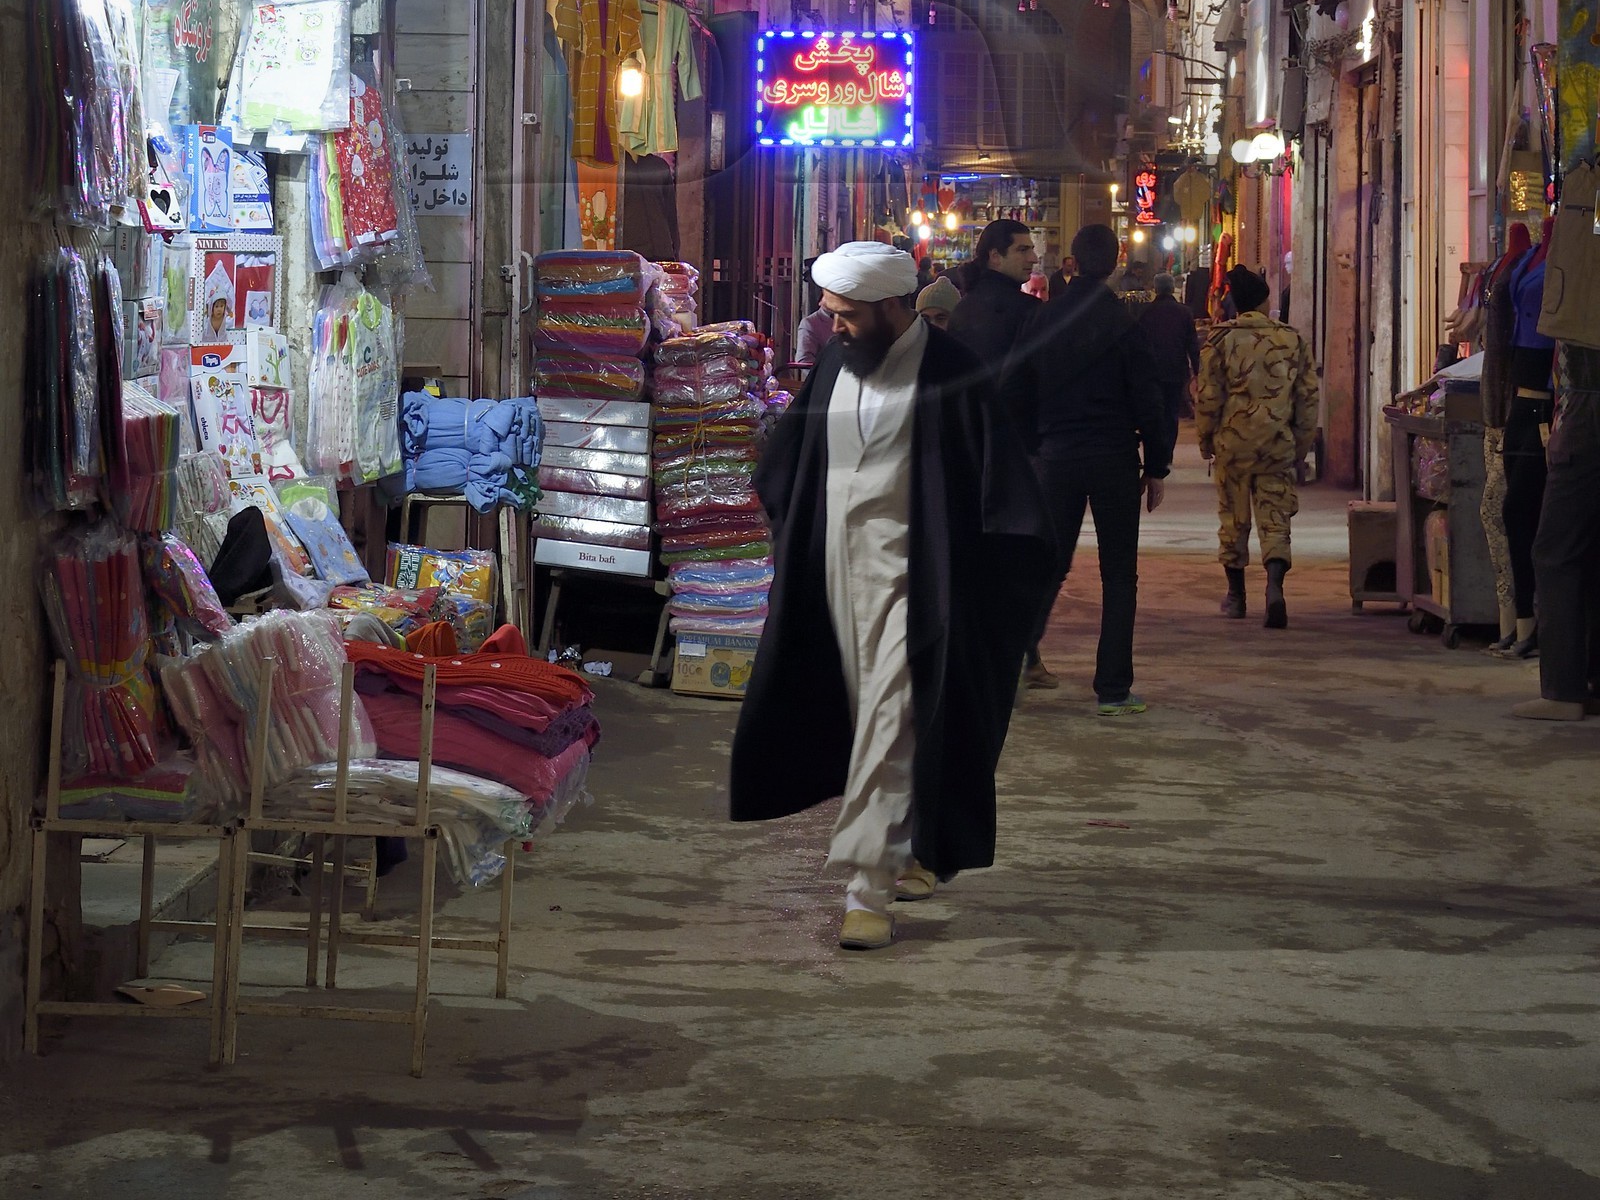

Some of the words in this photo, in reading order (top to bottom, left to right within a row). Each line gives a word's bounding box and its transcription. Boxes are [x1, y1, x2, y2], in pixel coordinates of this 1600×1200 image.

[794, 36, 875, 76] پخش
[857, 71, 906, 105] شال
[407, 136, 449, 161] تولید
[424, 188, 468, 211] داخل
[579, 552, 597, 563] Bita
[599, 554, 616, 565] baft
